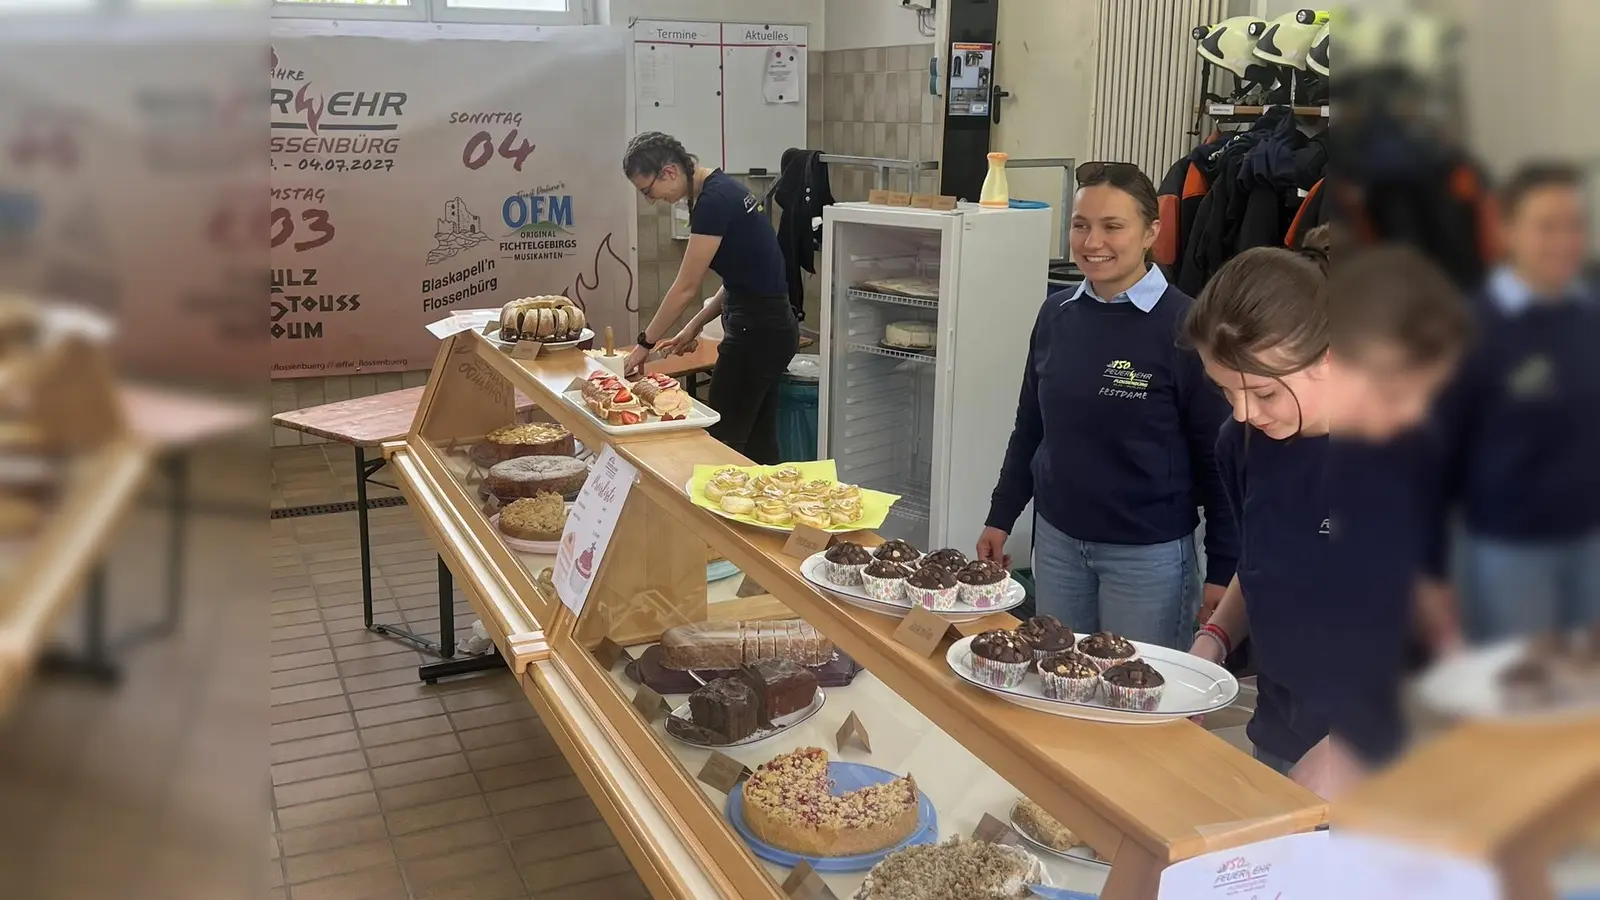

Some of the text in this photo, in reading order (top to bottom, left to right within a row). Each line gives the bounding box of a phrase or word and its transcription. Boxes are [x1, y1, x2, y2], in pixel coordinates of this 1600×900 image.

[656, 28, 697, 40] Termine
[745, 30, 789, 41] Aktuelles
[449, 112, 523, 127] SONNTAG
[463, 129, 536, 171] 04
[298, 158, 395, 172] 04.07.2027
[502, 195, 573, 228] OFM
[271, 207, 336, 252] 03
[520, 230, 557, 239] ORIGINAL
[500, 239, 577, 251] FICHTELGEBIRGS
[514, 252, 563, 261] MUSIKANTEN
[423, 277, 498, 312] Flossenbürg
[1112, 359, 1131, 369] 150
[1098, 387, 1148, 400] FESTDAME
